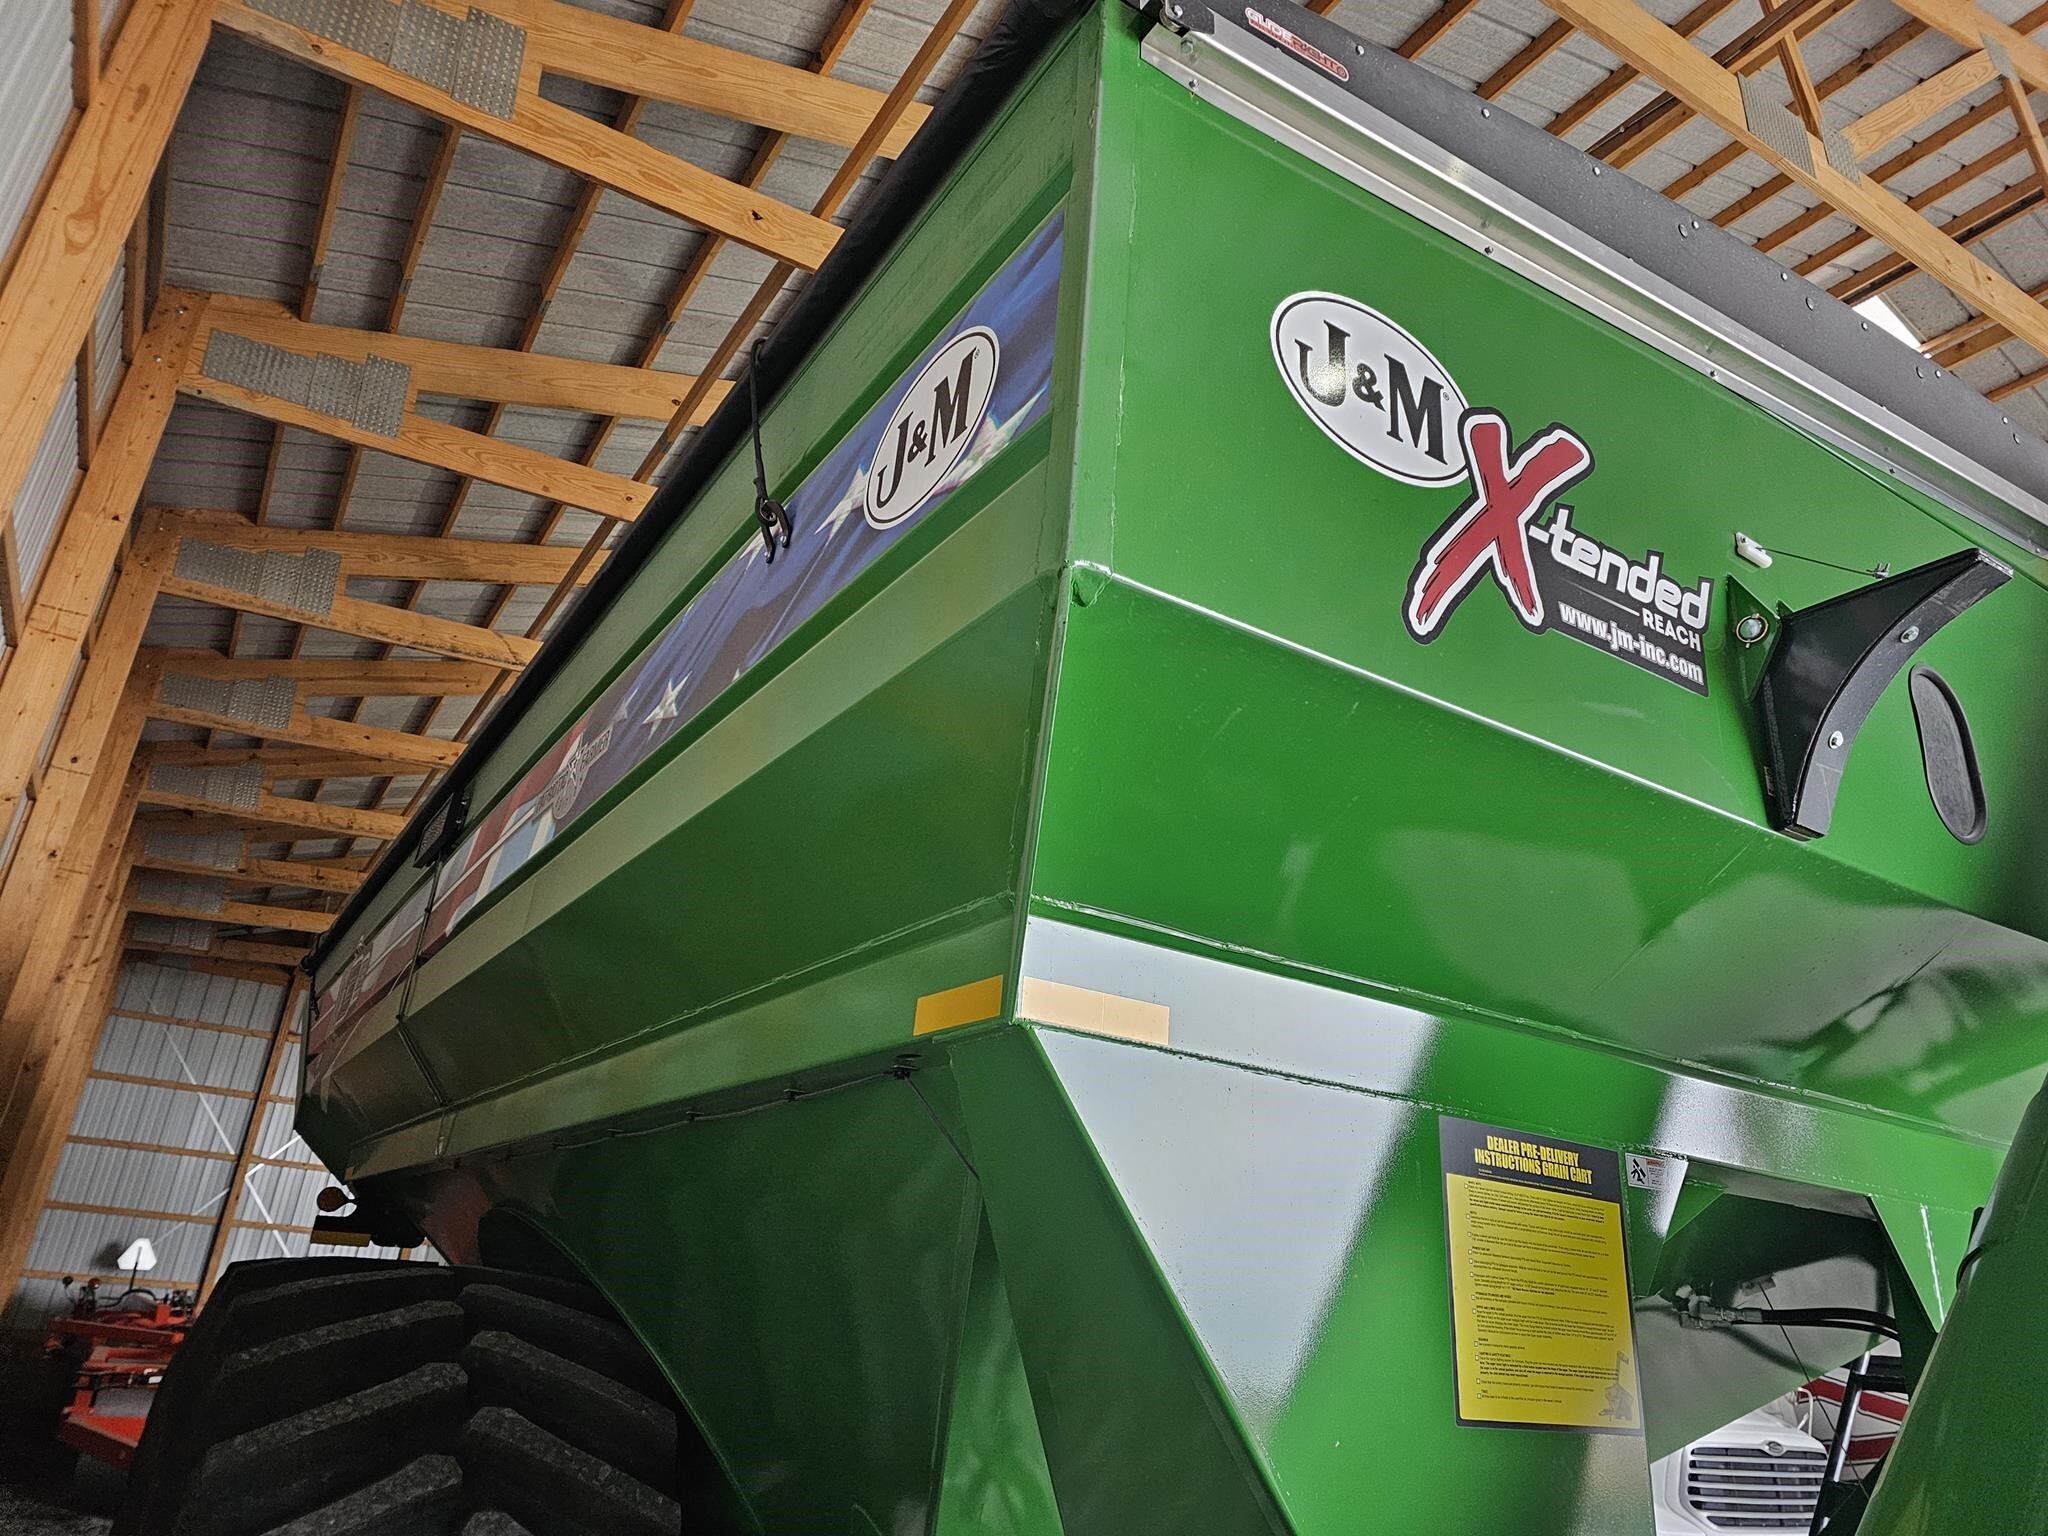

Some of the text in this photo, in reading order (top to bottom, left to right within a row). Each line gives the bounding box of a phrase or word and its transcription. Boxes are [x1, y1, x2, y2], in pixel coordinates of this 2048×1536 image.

[1295, 320, 1447, 465] J&M
[877, 347, 975, 508] J&M
[1557, 600, 1704, 686] www.jm-inc.com
[1641, 607, 1701, 652] REACH
[1474, 1148, 1541, 1175] INSTRUCTIONS
[1541, 1161, 1569, 1181] GRAIN
[1570, 1166, 1593, 1185] CART
[1486, 1135, 1579, 1167] DEALER PRE-DELIVERY
